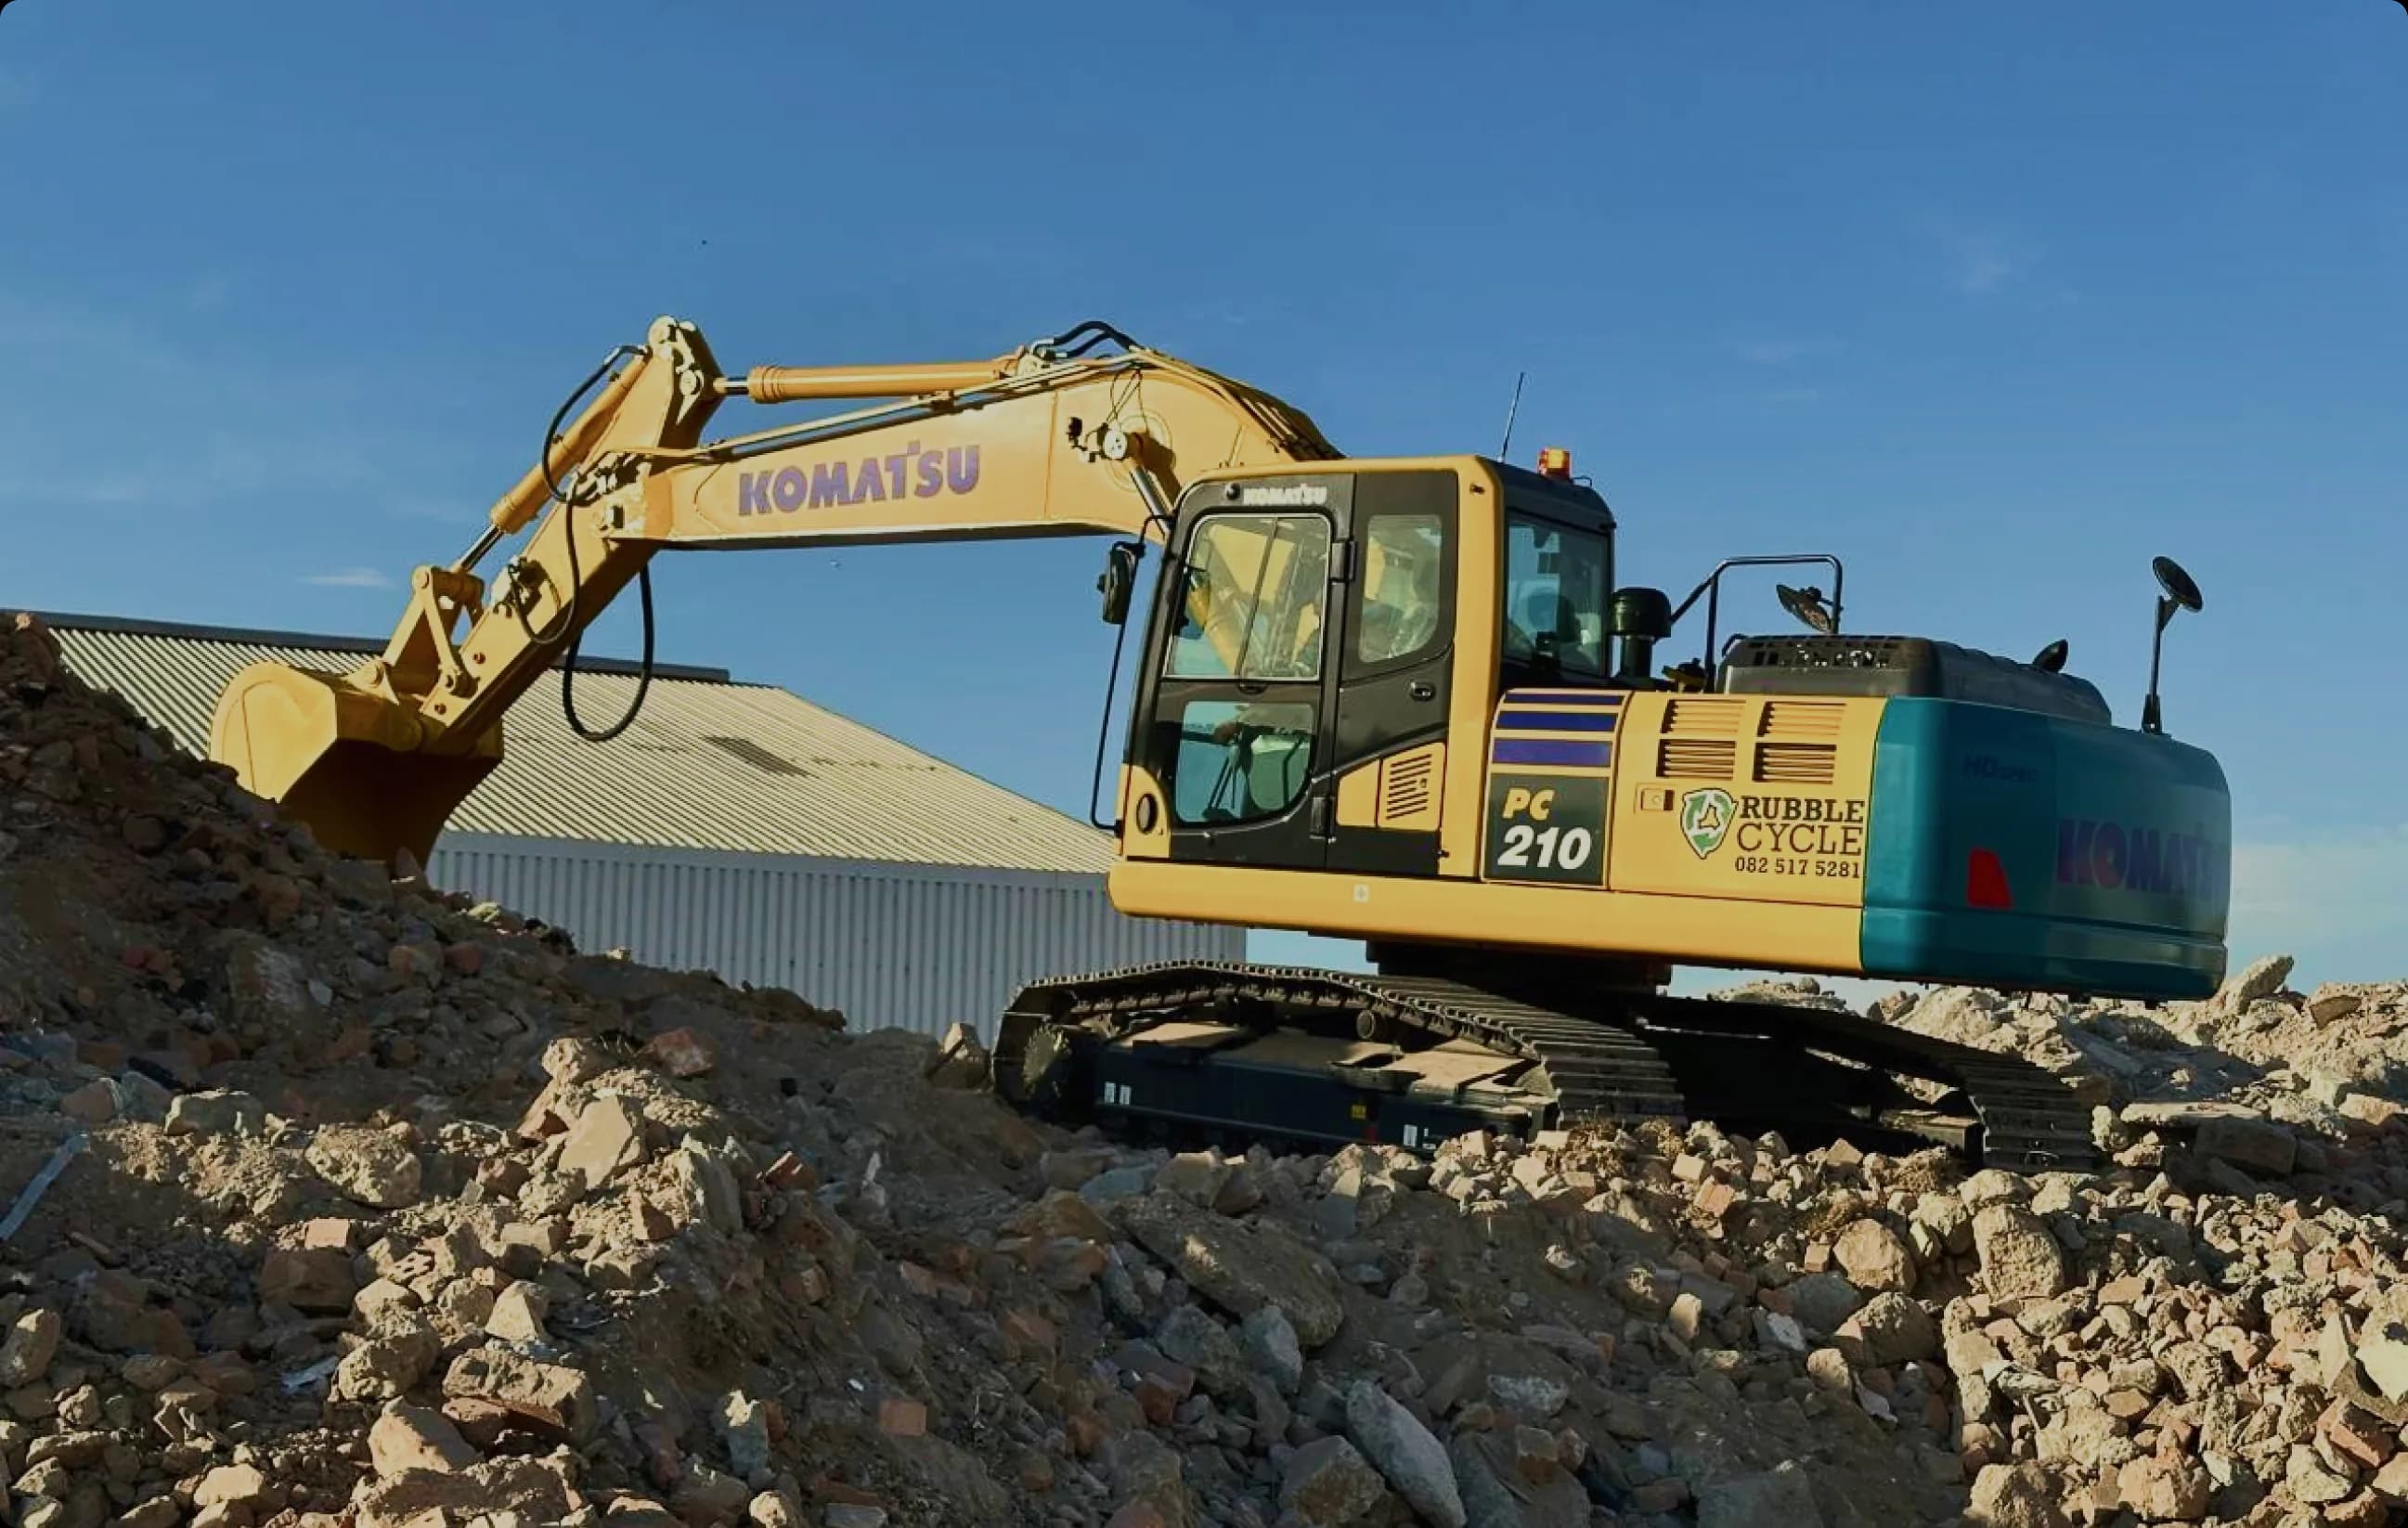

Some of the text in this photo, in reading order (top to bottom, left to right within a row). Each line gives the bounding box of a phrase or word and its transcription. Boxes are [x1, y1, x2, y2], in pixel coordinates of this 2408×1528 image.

[739, 440, 980, 516] KOMATSU
[1502, 787, 1556, 821] PC
[1740, 796, 1865, 822] RUBBLE
[1497, 824, 1592, 870] 210
[1737, 822, 1863, 856] CYCLE
[1735, 856, 1860, 878] 082 517 5281
